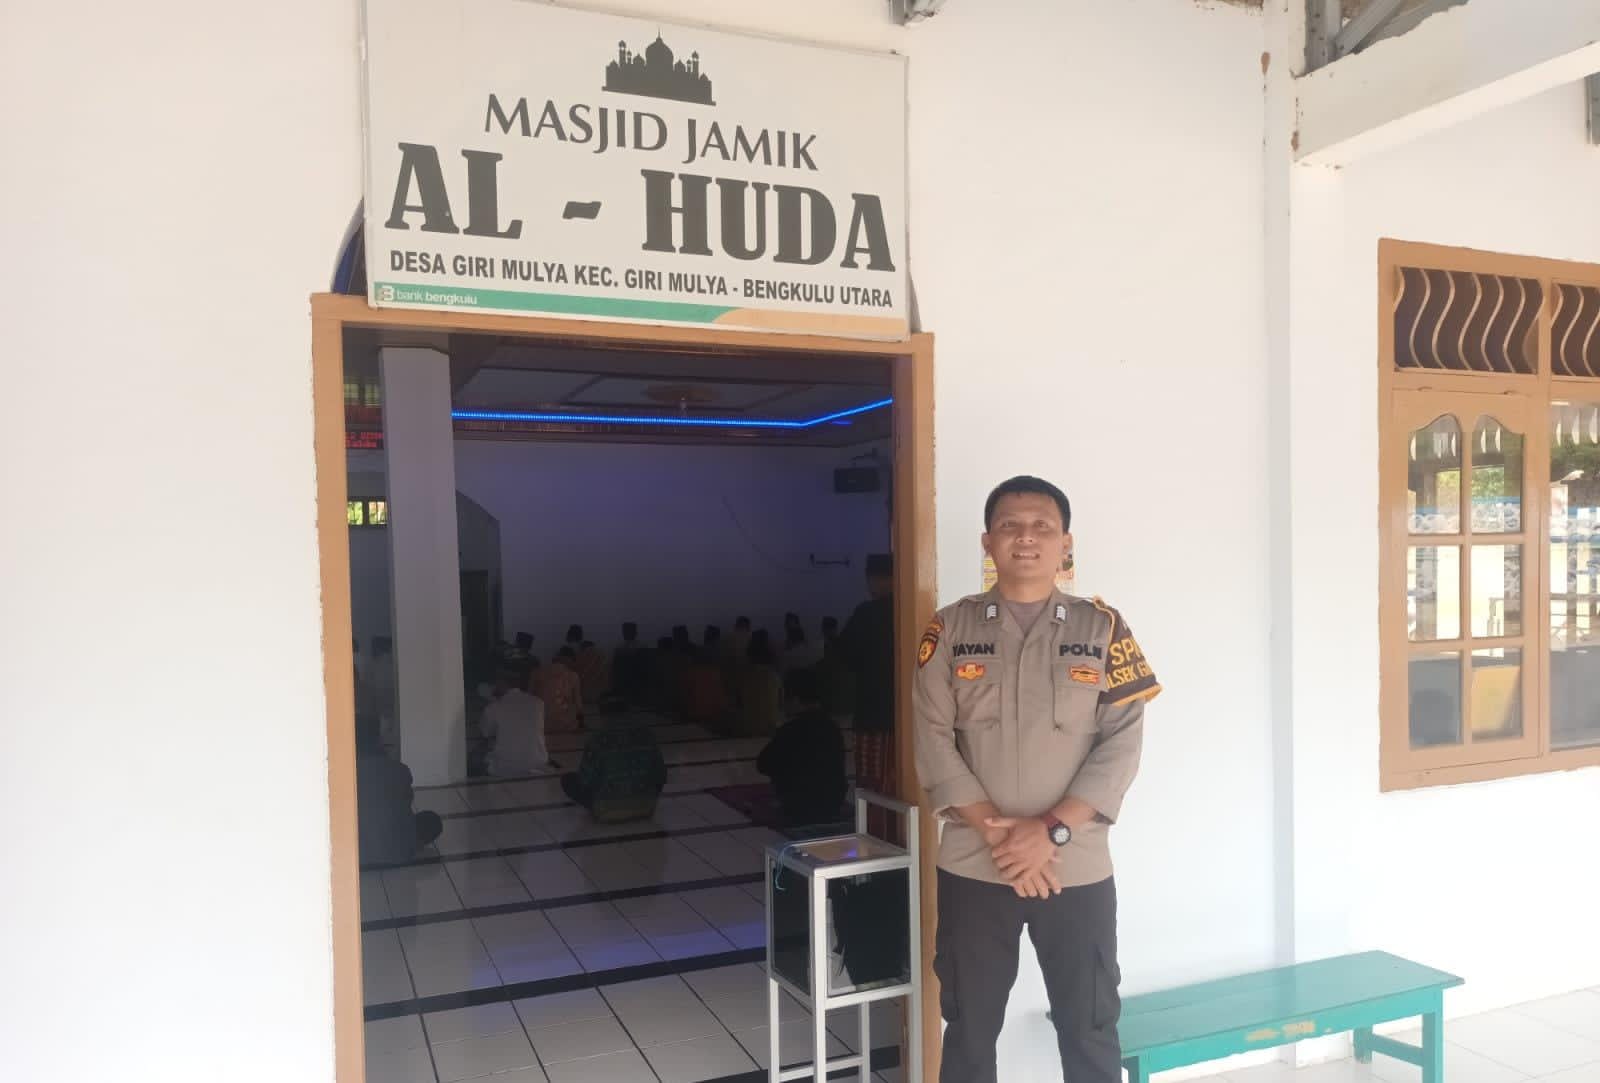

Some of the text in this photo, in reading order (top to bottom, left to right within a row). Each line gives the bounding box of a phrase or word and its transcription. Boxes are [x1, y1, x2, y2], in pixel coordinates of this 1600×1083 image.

[485, 94, 818, 171] MASJID JAMIK
[385, 142, 523, 239] AL
[641, 169, 895, 272] HUDA
[390, 250, 446, 274] DESA
[453, 255, 495, 278] GIRI
[502, 259, 568, 284] MULYA
[574, 265, 618, 287] KEC.
[625, 269, 662, 290] GIRI
[668, 272, 728, 295] MULYA
[743, 279, 834, 303] BENGKULU
[840, 287, 893, 308] UTARA
[397, 291, 423, 301] bank
[425, 292, 477, 305] bengkulu
[1106, 664, 1138, 689] LSEK
